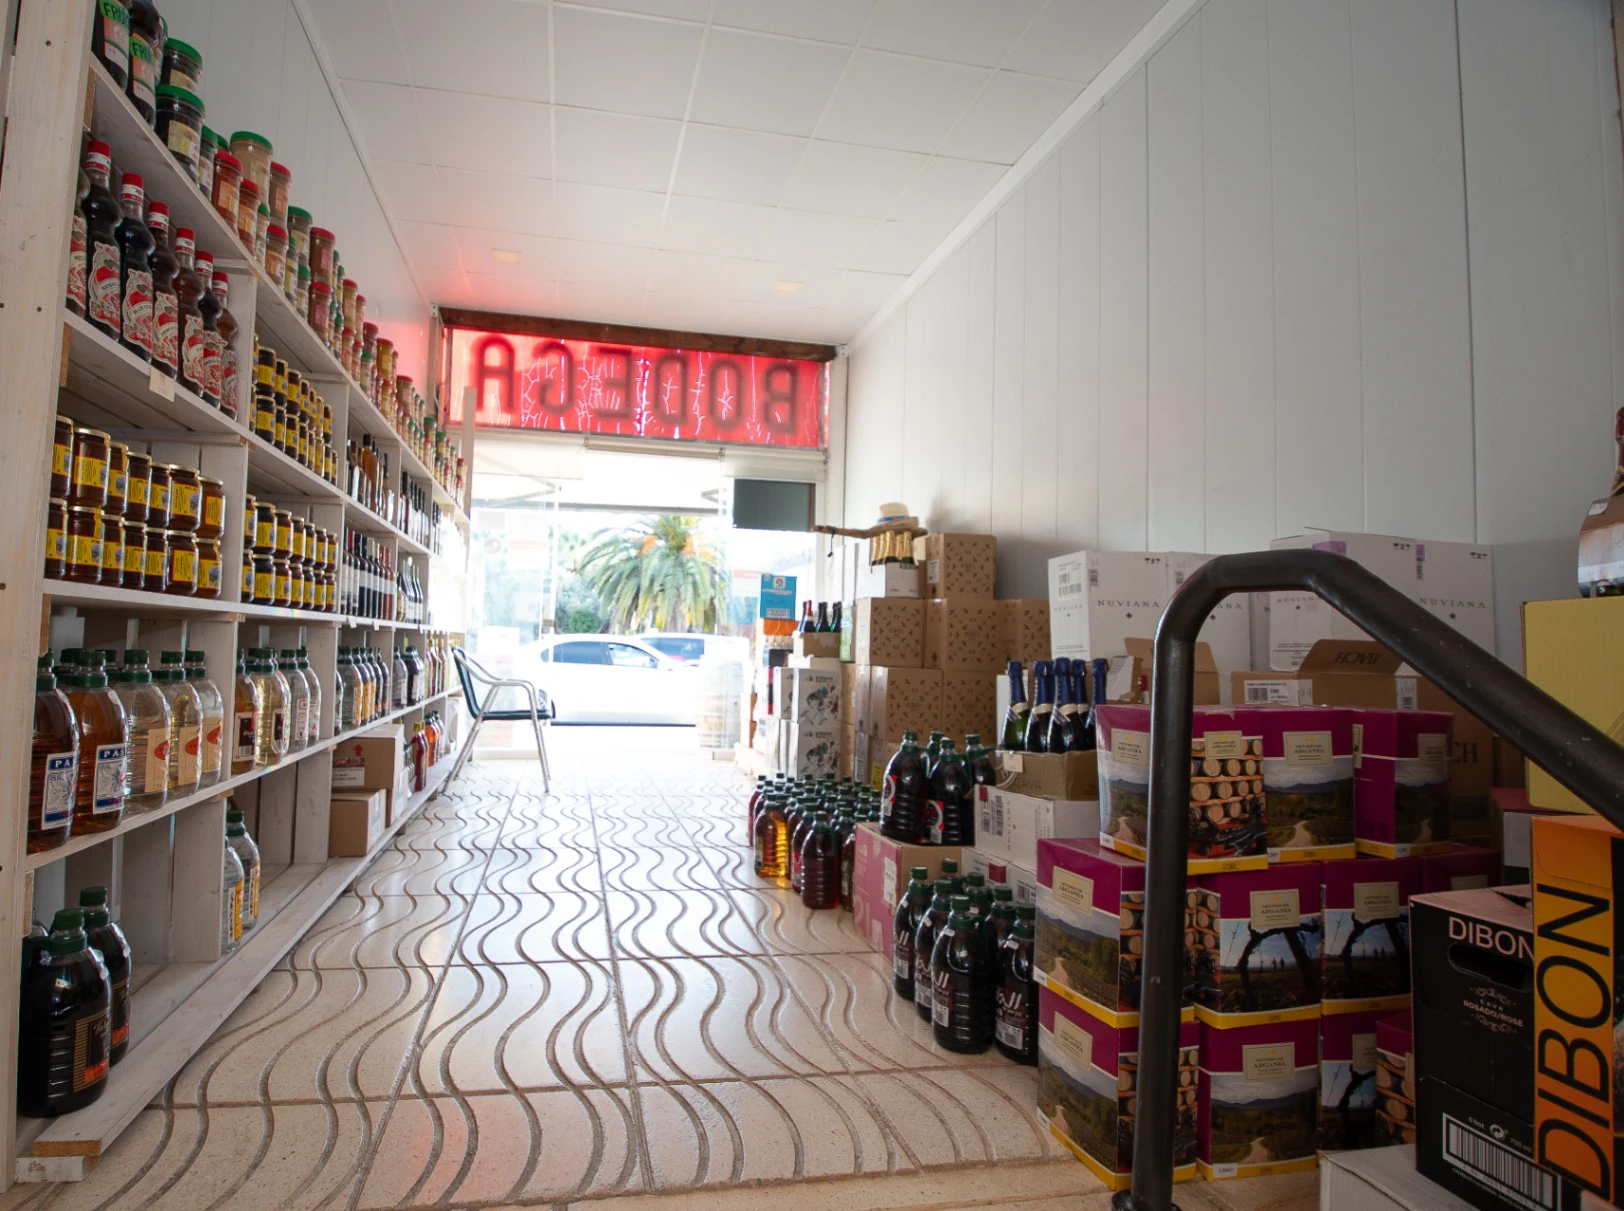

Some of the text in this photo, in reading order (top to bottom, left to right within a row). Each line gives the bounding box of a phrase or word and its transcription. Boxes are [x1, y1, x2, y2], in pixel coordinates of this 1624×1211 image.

[1096, 599, 1160, 609] NUVIANA
[1419, 597, 1486, 610] NUVIANA
[1448, 915, 1534, 961] DIBON
[1462, 999, 1524, 1028] ROSADO/ROSÉ
[1479, 998, 1504, 1012] CAVA
[1537, 883, 1611, 1203] DIBON
